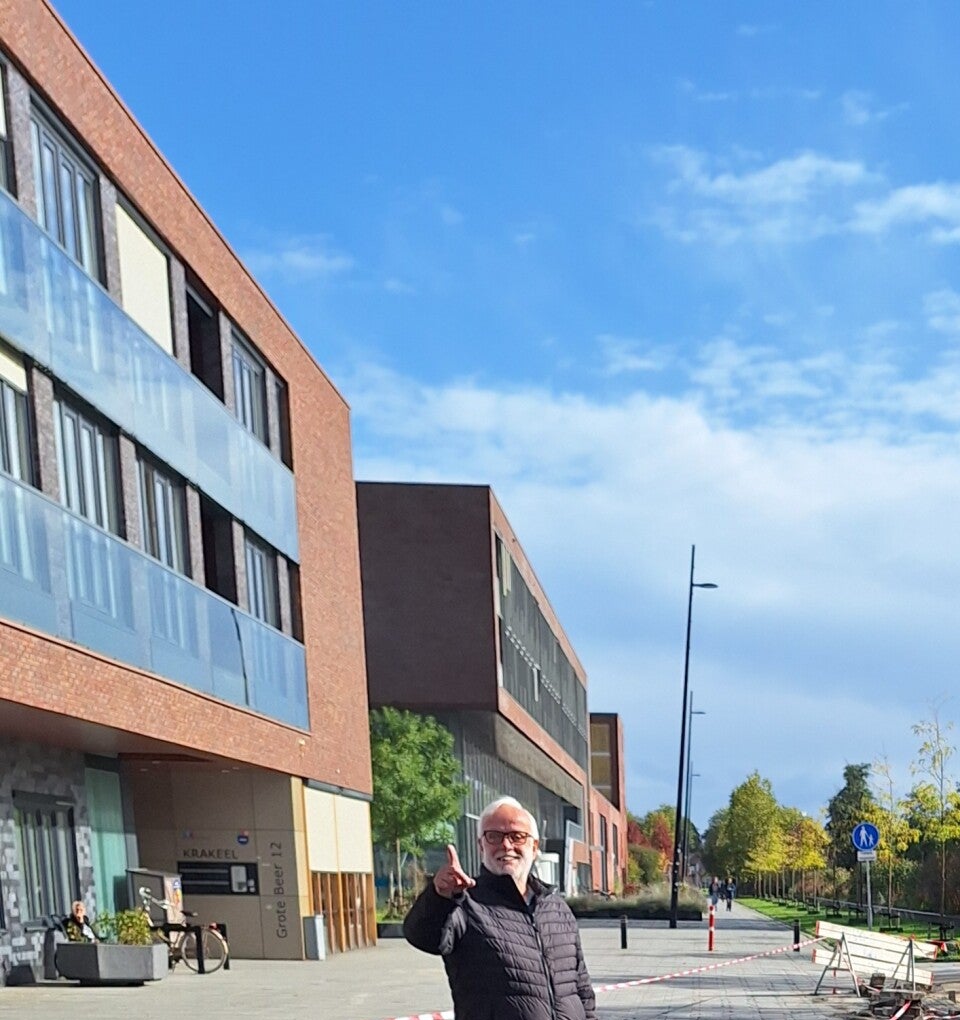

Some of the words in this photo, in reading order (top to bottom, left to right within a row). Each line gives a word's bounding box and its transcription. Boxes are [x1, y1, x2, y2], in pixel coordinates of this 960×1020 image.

[183, 848, 239, 860] KRAKEEL
[270, 842, 282, 857] 12
[273, 863, 285, 895] Beer
[276, 900, 288, 939] Grote
